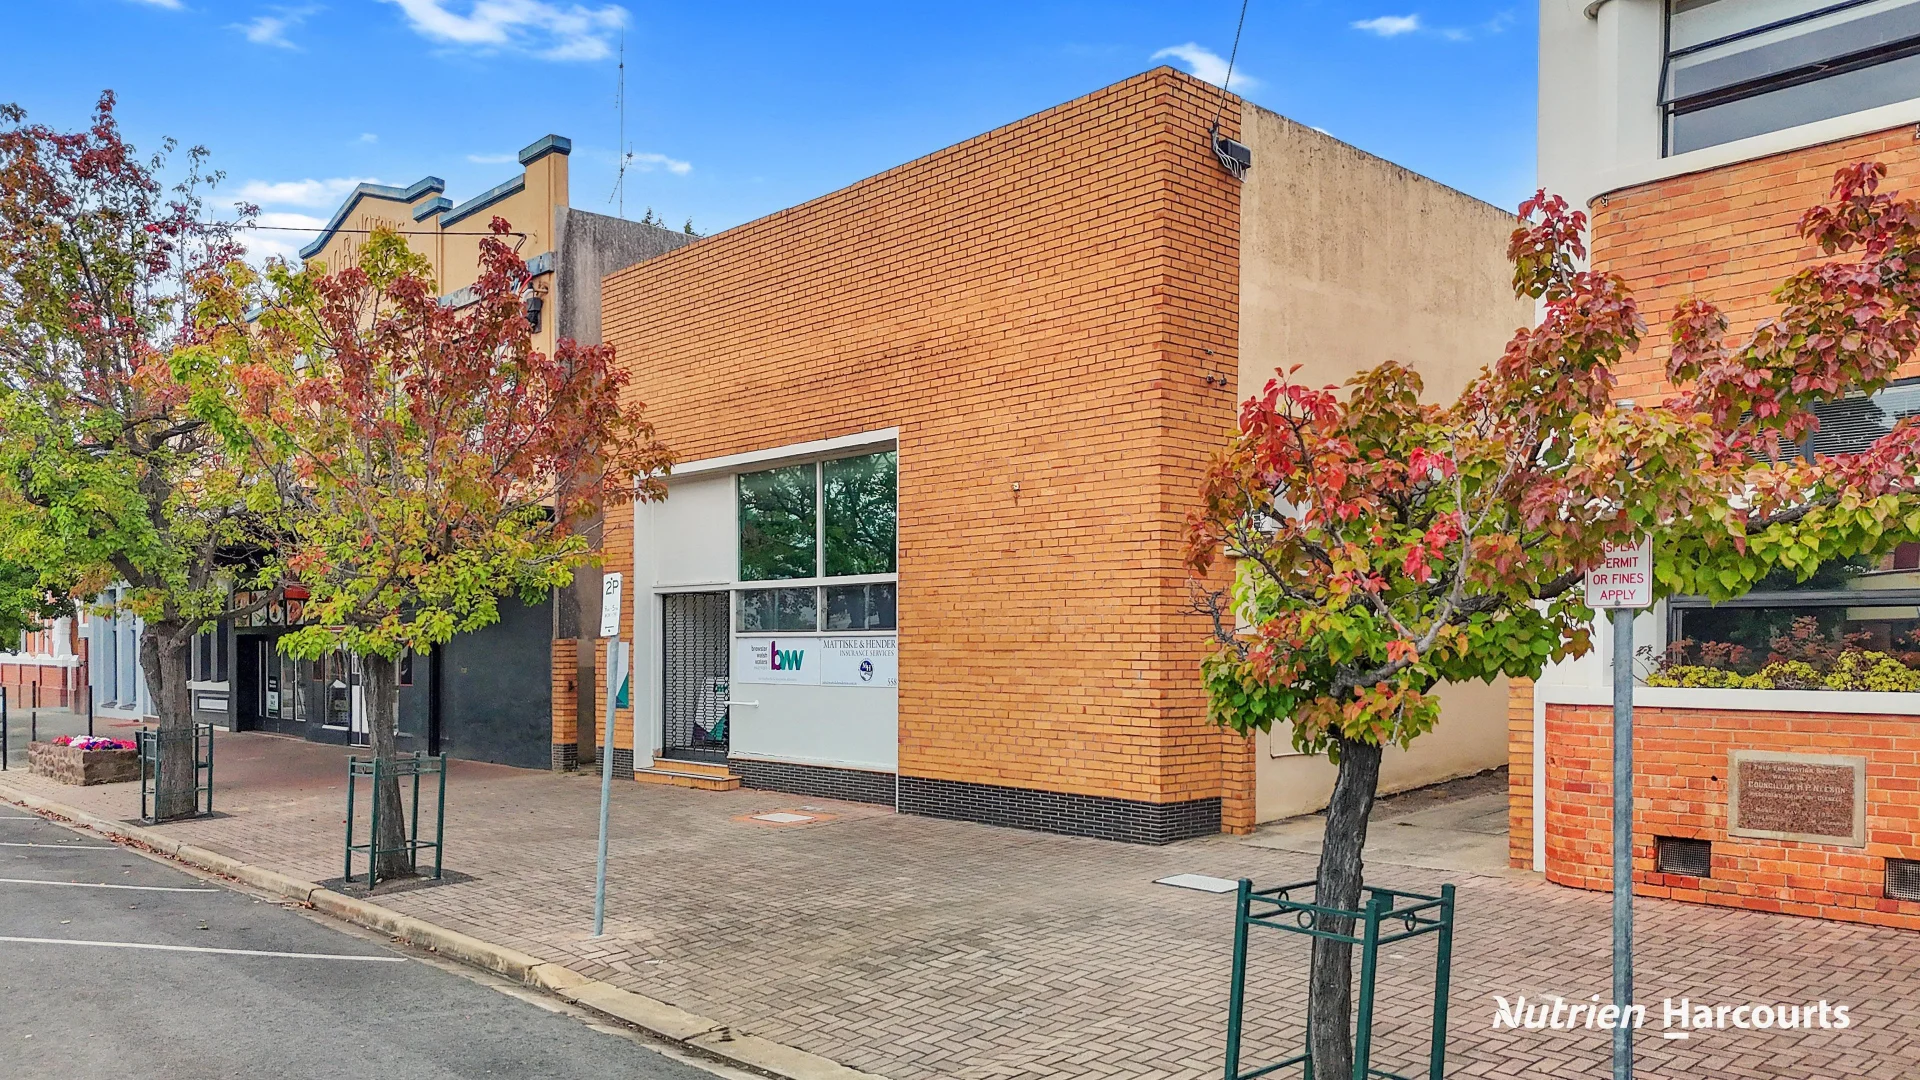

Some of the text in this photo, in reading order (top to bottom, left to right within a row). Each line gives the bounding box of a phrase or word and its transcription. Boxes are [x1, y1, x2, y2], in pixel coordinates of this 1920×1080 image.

[1602, 541, 1641, 553] ISLAY
[1604, 557, 1639, 568] ERMIT
[1593, 573, 1644, 585] OR FINES
[606, 580, 619, 595] 2P
[1600, 590, 1636, 600] APPLY
[823, 640, 858, 649] MATTISKE
[859, 640, 865, 649] &
